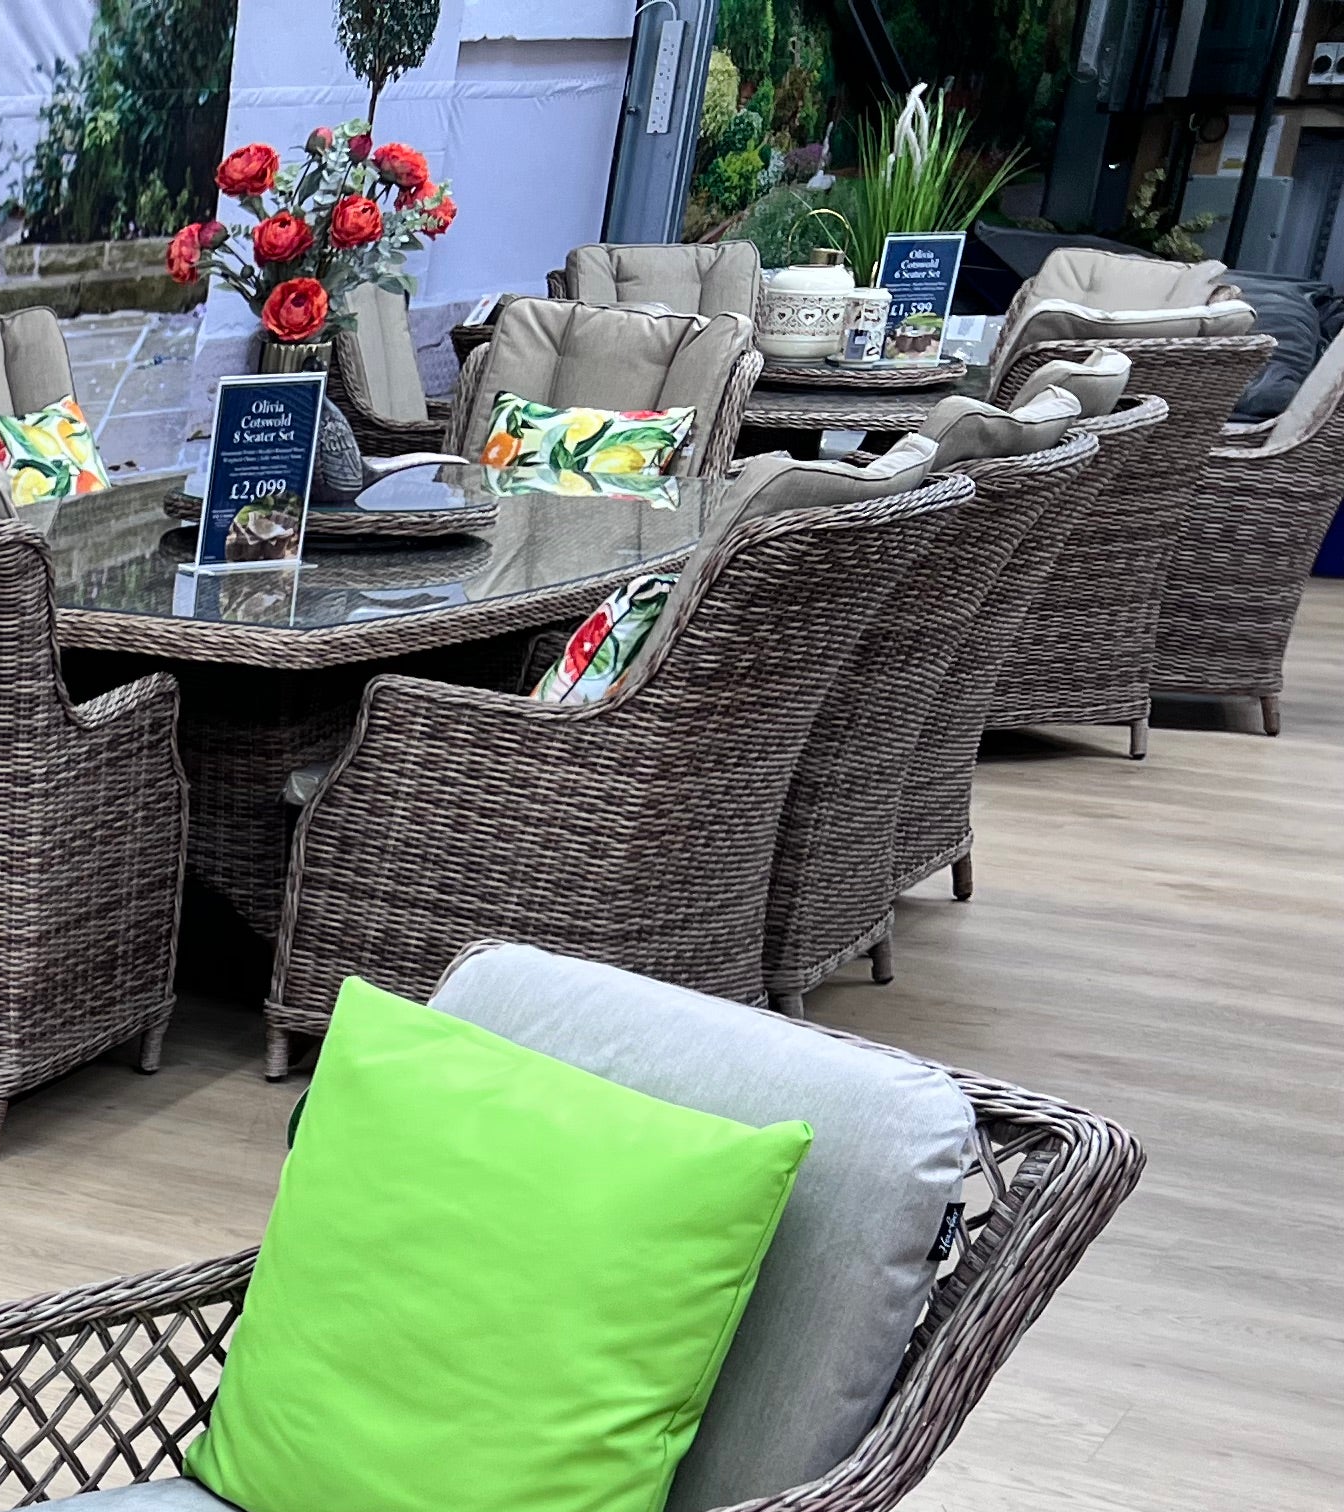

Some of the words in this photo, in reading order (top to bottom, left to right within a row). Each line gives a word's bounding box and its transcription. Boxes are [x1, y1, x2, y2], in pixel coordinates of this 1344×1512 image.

[889, 302, 933, 317] £1,599
[251, 399, 285, 414] Olivia
[240, 413, 292, 429] Cotswold
[233, 431, 241, 444] 8
[242, 430, 277, 444] Seater
[278, 428, 295, 442] Set
[228, 478, 287, 503] £2,099
